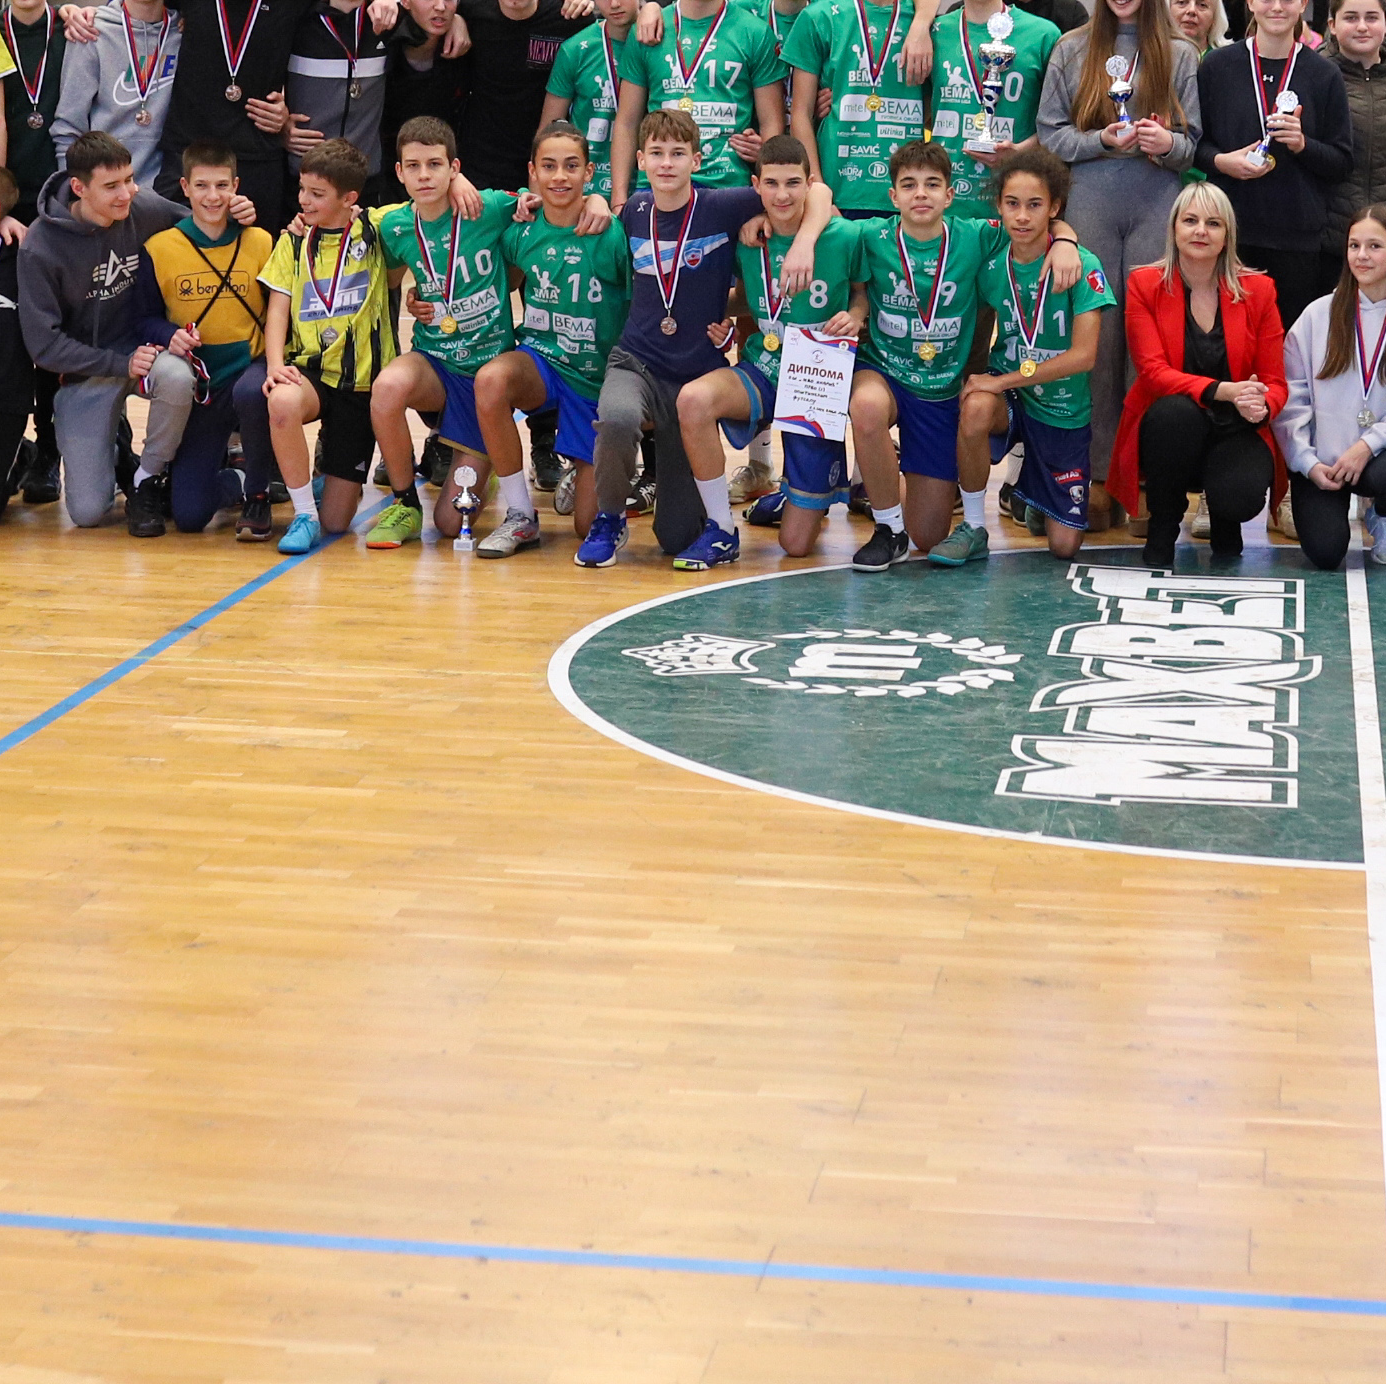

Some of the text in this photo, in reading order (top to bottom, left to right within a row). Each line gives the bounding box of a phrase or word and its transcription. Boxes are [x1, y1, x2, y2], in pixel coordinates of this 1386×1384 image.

[704, 59, 743, 89] 17
[593, 98, 616, 108] BEM
[691, 105, 733, 117] BEMA
[878, 101, 922, 116] BEMA
[965, 118, 1011, 134] BMA
[850, 144, 880, 154] SAVIĆ
[455, 249, 493, 283] 10
[568, 273, 603, 303] 18
[809, 280, 828, 308] 8
[940, 281, 957, 306] 9
[451, 290, 495, 315] BEMA
[759, 297, 791, 308] BA
[882, 294, 918, 307] BEMA
[554, 317, 594, 332] BEMA
[787, 363, 844, 381] ДИПЛОМА
[994, 563, 1322, 808] MAXBET
